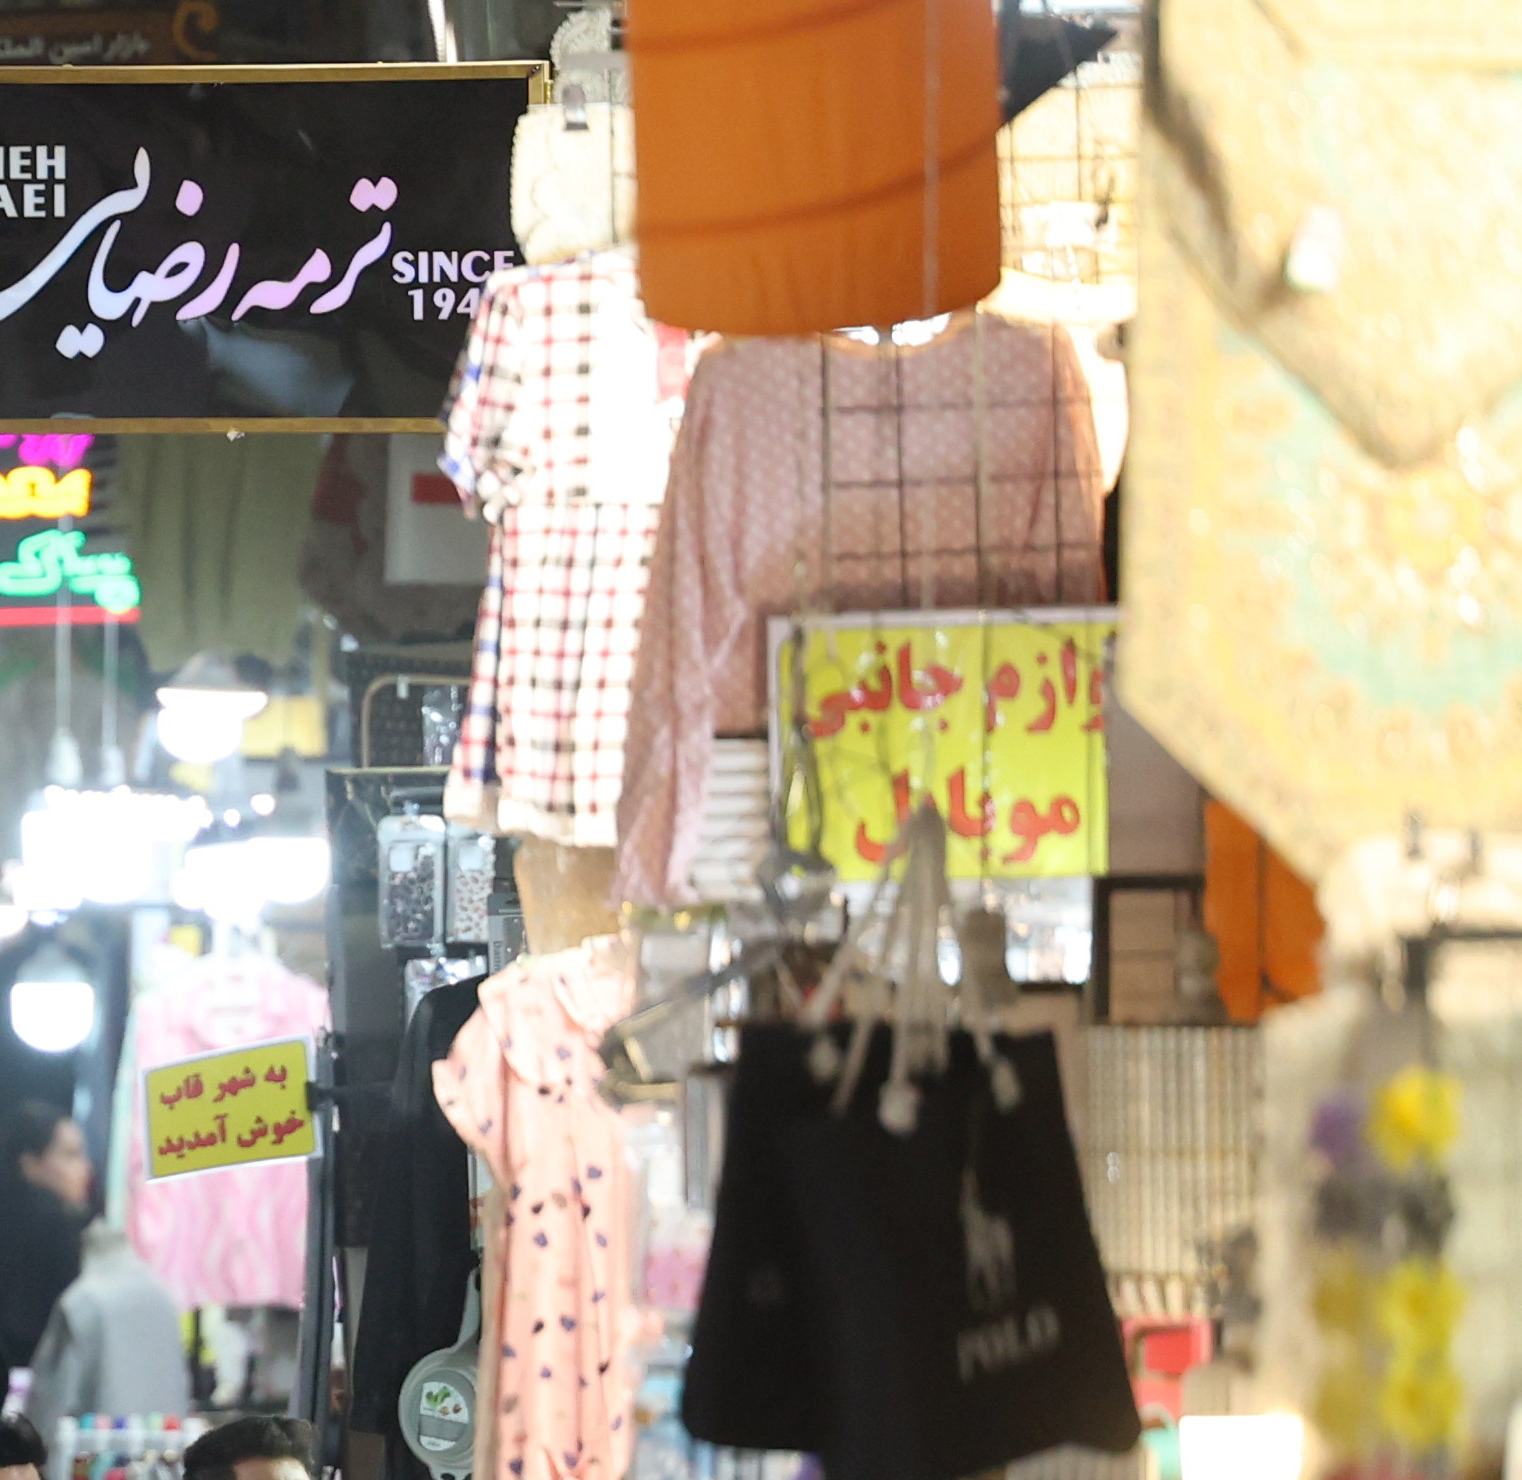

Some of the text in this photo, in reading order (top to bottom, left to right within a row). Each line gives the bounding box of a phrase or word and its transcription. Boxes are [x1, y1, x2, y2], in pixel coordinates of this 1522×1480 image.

[231, 176, 399, 320] ترمه
[391, 250, 515, 284] SINCE
[407, 287, 481, 320] 194
[805, 639, 964, 739] جانبی
[855, 767, 1081, 865] موبال
[160, 1064, 288, 1110] به شهر قاب
[158, 1109, 305, 1159] خوش آمدید
[958, 1302, 1060, 1385] POLO
